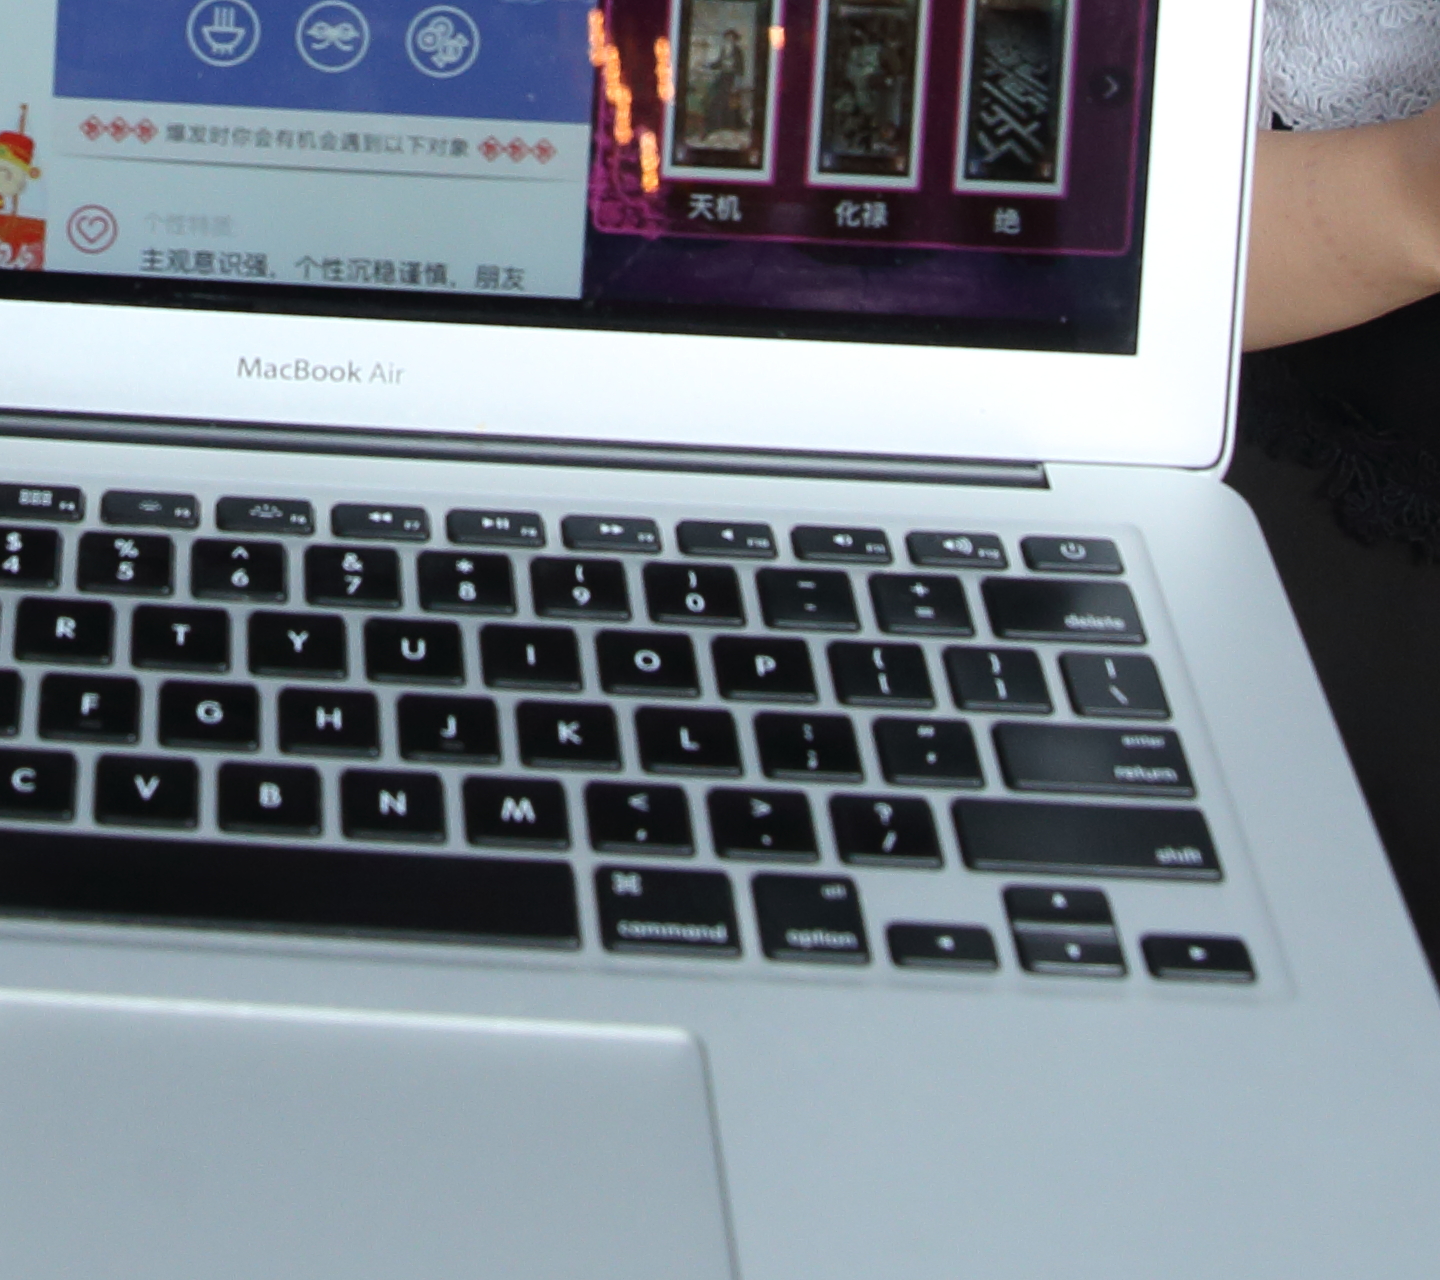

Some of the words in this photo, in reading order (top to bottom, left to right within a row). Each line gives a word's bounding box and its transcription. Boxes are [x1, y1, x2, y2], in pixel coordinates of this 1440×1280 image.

[687, 195, 743, 222] 天机
[237, 357, 362, 384] MacBook
[369, 361, 405, 385] Air
[2, 555, 20, 574] 4
[231, 569, 249, 588] 6
[345, 577, 362, 595] 7
[459, 581, 477, 601] 8
[572, 587, 591, 606] 9
[685, 593, 705, 612] 0
[56, 618, 76, 639] R
[171, 624, 191, 645] T
[288, 630, 309, 652] Y
[401, 639, 426, 661] U
[526, 644, 536, 665] I
[634, 650, 661, 672] O
[755, 655, 777, 677] P
[81, 692, 100, 716] F
[196, 701, 224, 724] G
[317, 707, 342, 730] H
[440, 715, 457, 738] J
[557, 721, 581, 745] K
[680, 727, 700, 751] L
[11, 768, 37, 792] C
[134, 774, 160, 800] V
[259, 782, 282, 808] B
[379, 790, 406, 816] N
[501, 797, 536, 824] M
[617, 920, 728, 942] command
